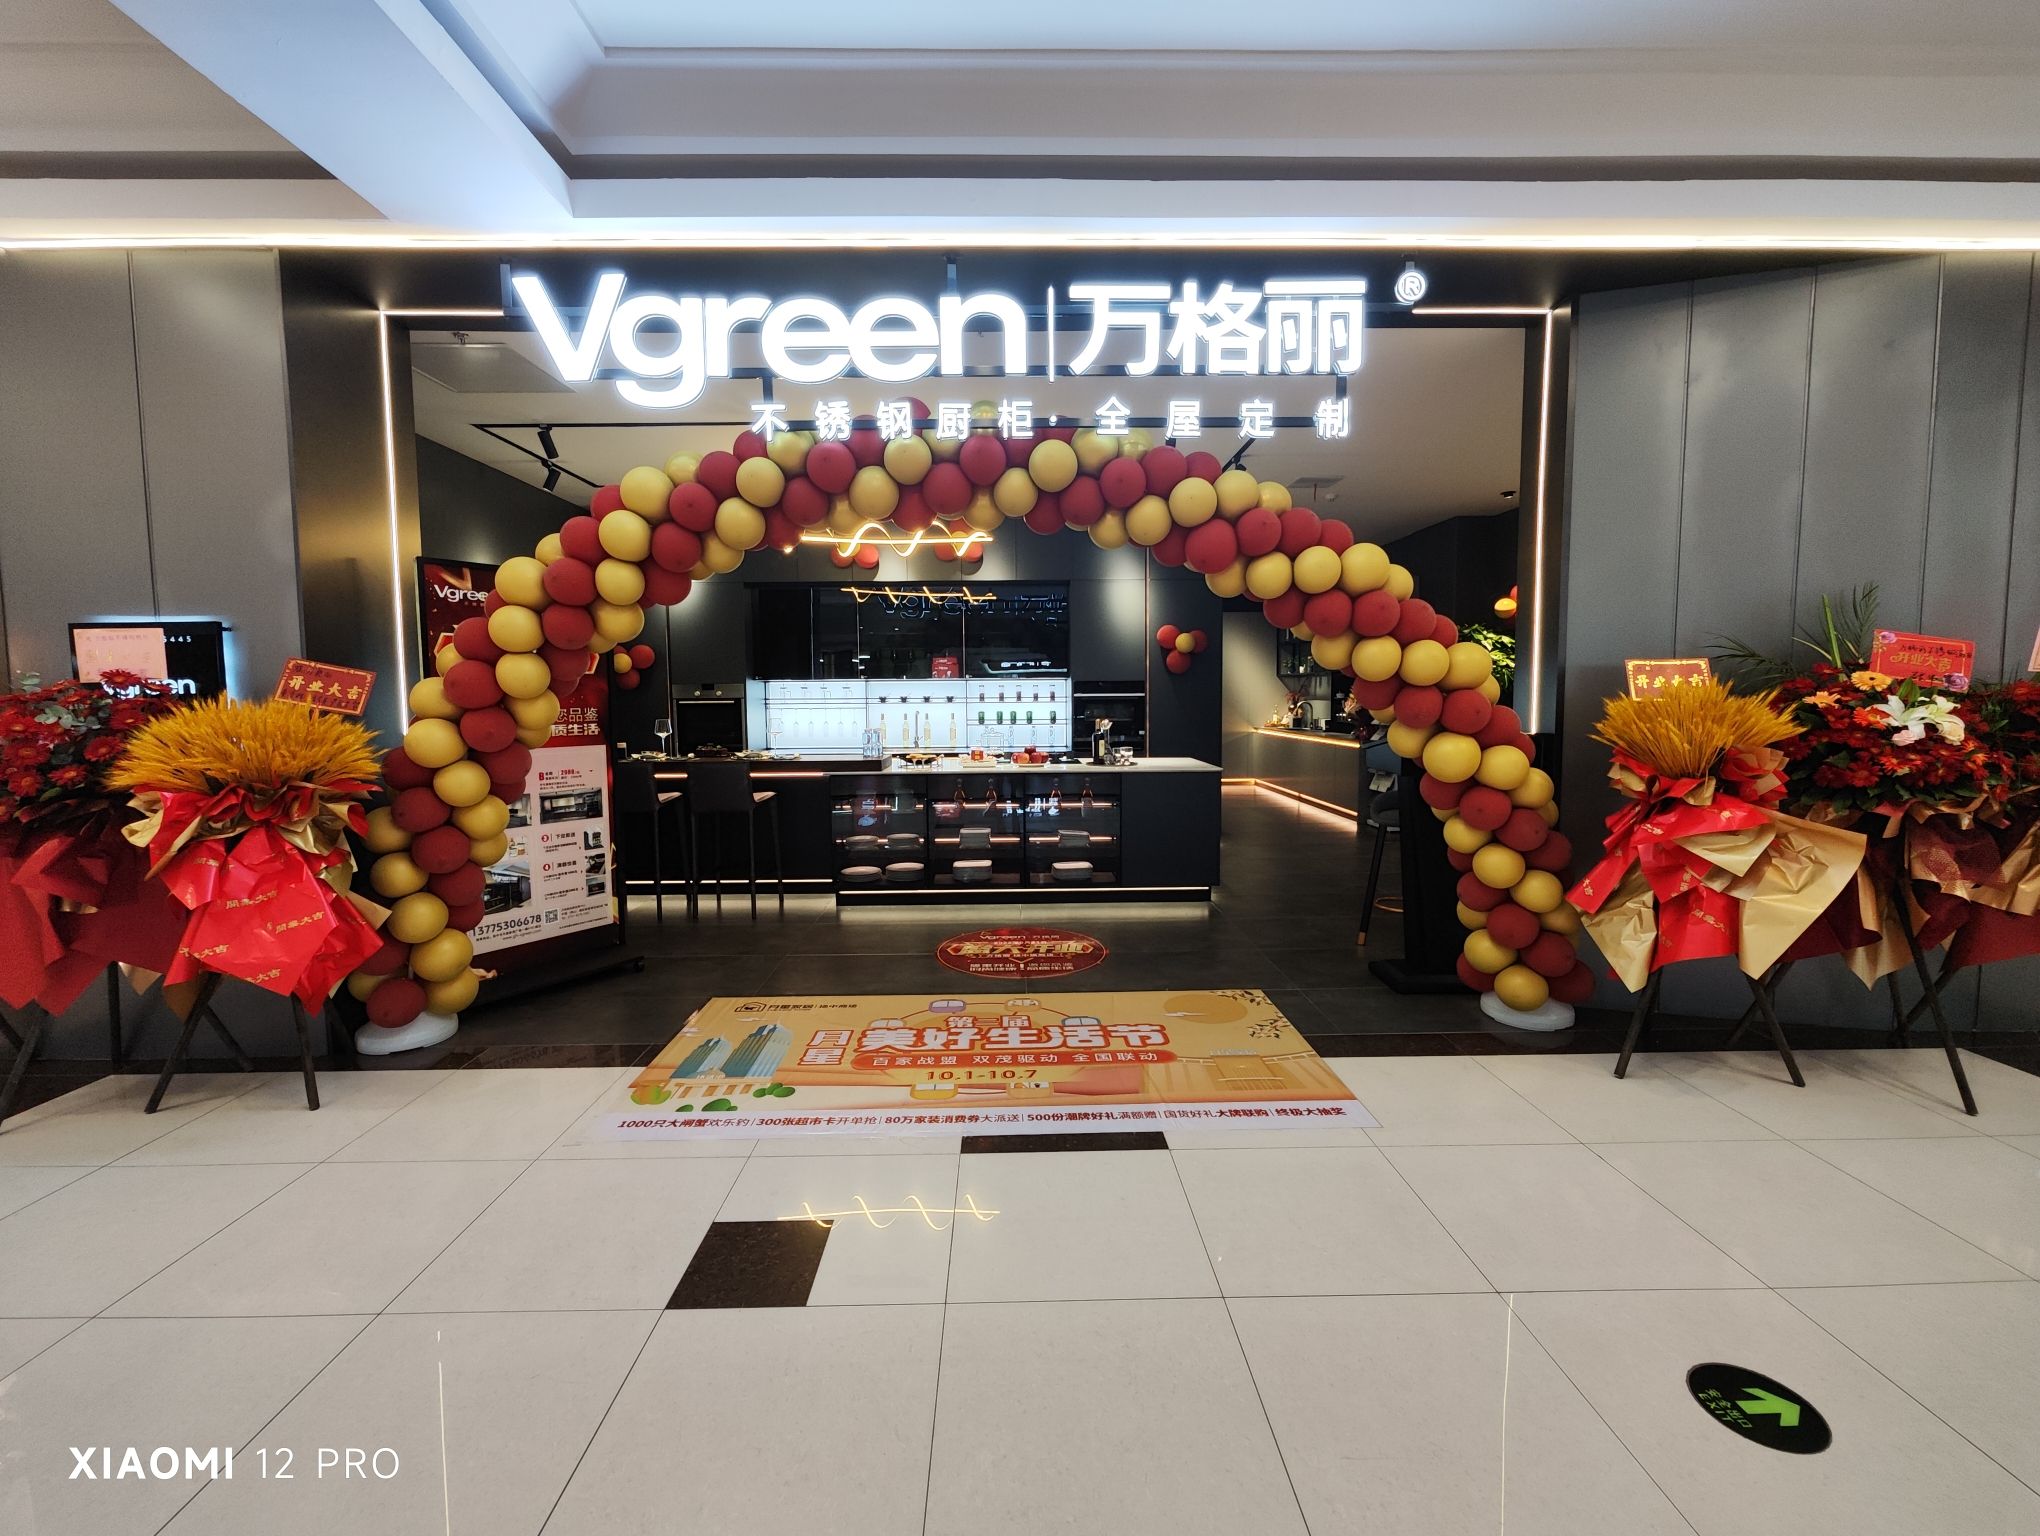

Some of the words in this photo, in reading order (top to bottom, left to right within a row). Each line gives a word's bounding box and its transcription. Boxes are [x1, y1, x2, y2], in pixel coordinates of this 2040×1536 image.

[511, 270, 1026, 408] Vgreen
[1068, 279, 1368, 378] 万格丽
[433, 584, 489, 603] Vgree
[287, 675, 363, 700] 开业大吉
[856, 1024, 1171, 1052] 美好生活节
[926, 1069, 1040, 1082] 10.1-10.7
